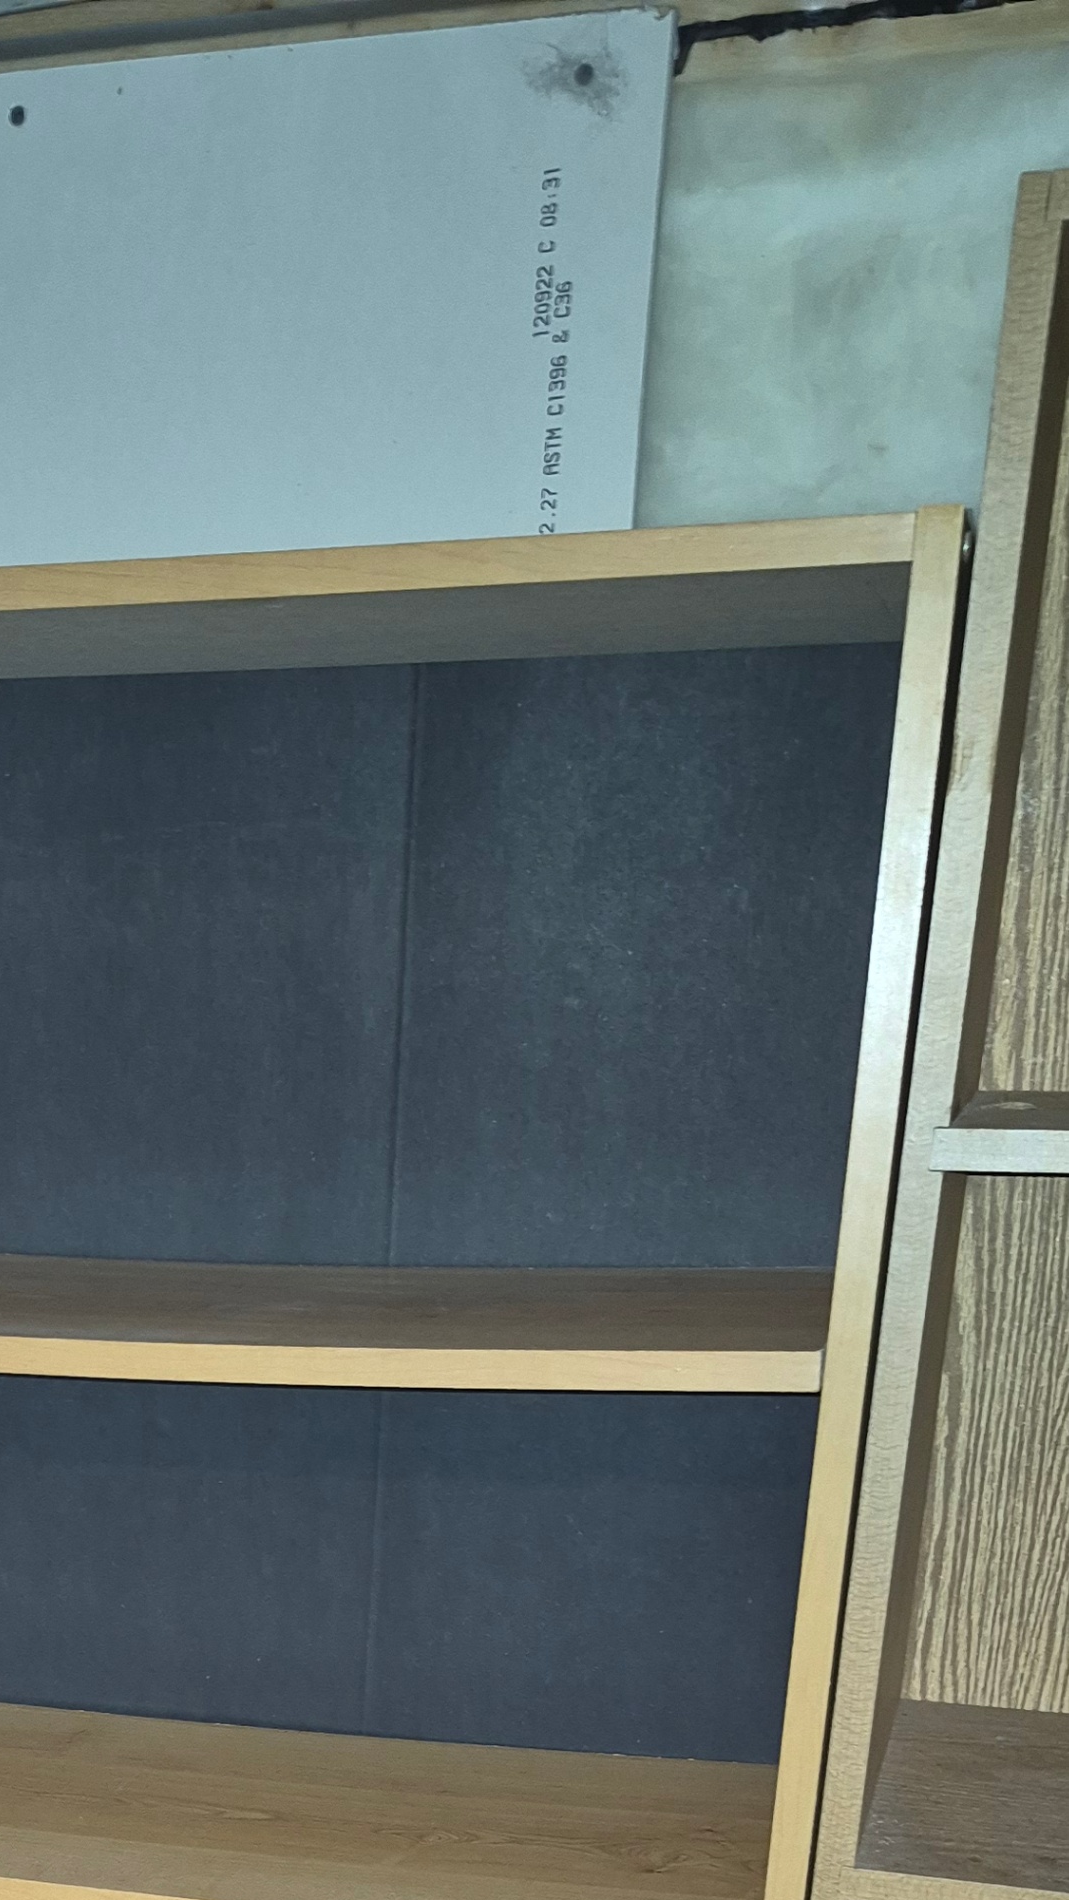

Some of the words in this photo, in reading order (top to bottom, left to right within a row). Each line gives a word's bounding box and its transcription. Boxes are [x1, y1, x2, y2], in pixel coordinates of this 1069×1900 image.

[540, 166, 562, 228] 08:31
[537, 240, 556, 254] C
[532, 264, 555, 338] 120922
[553, 280, 573, 320] C36
[551, 330, 571, 344] &
[546, 354, 569, 417] C1396
[542, 426, 563, 477] ASTM
